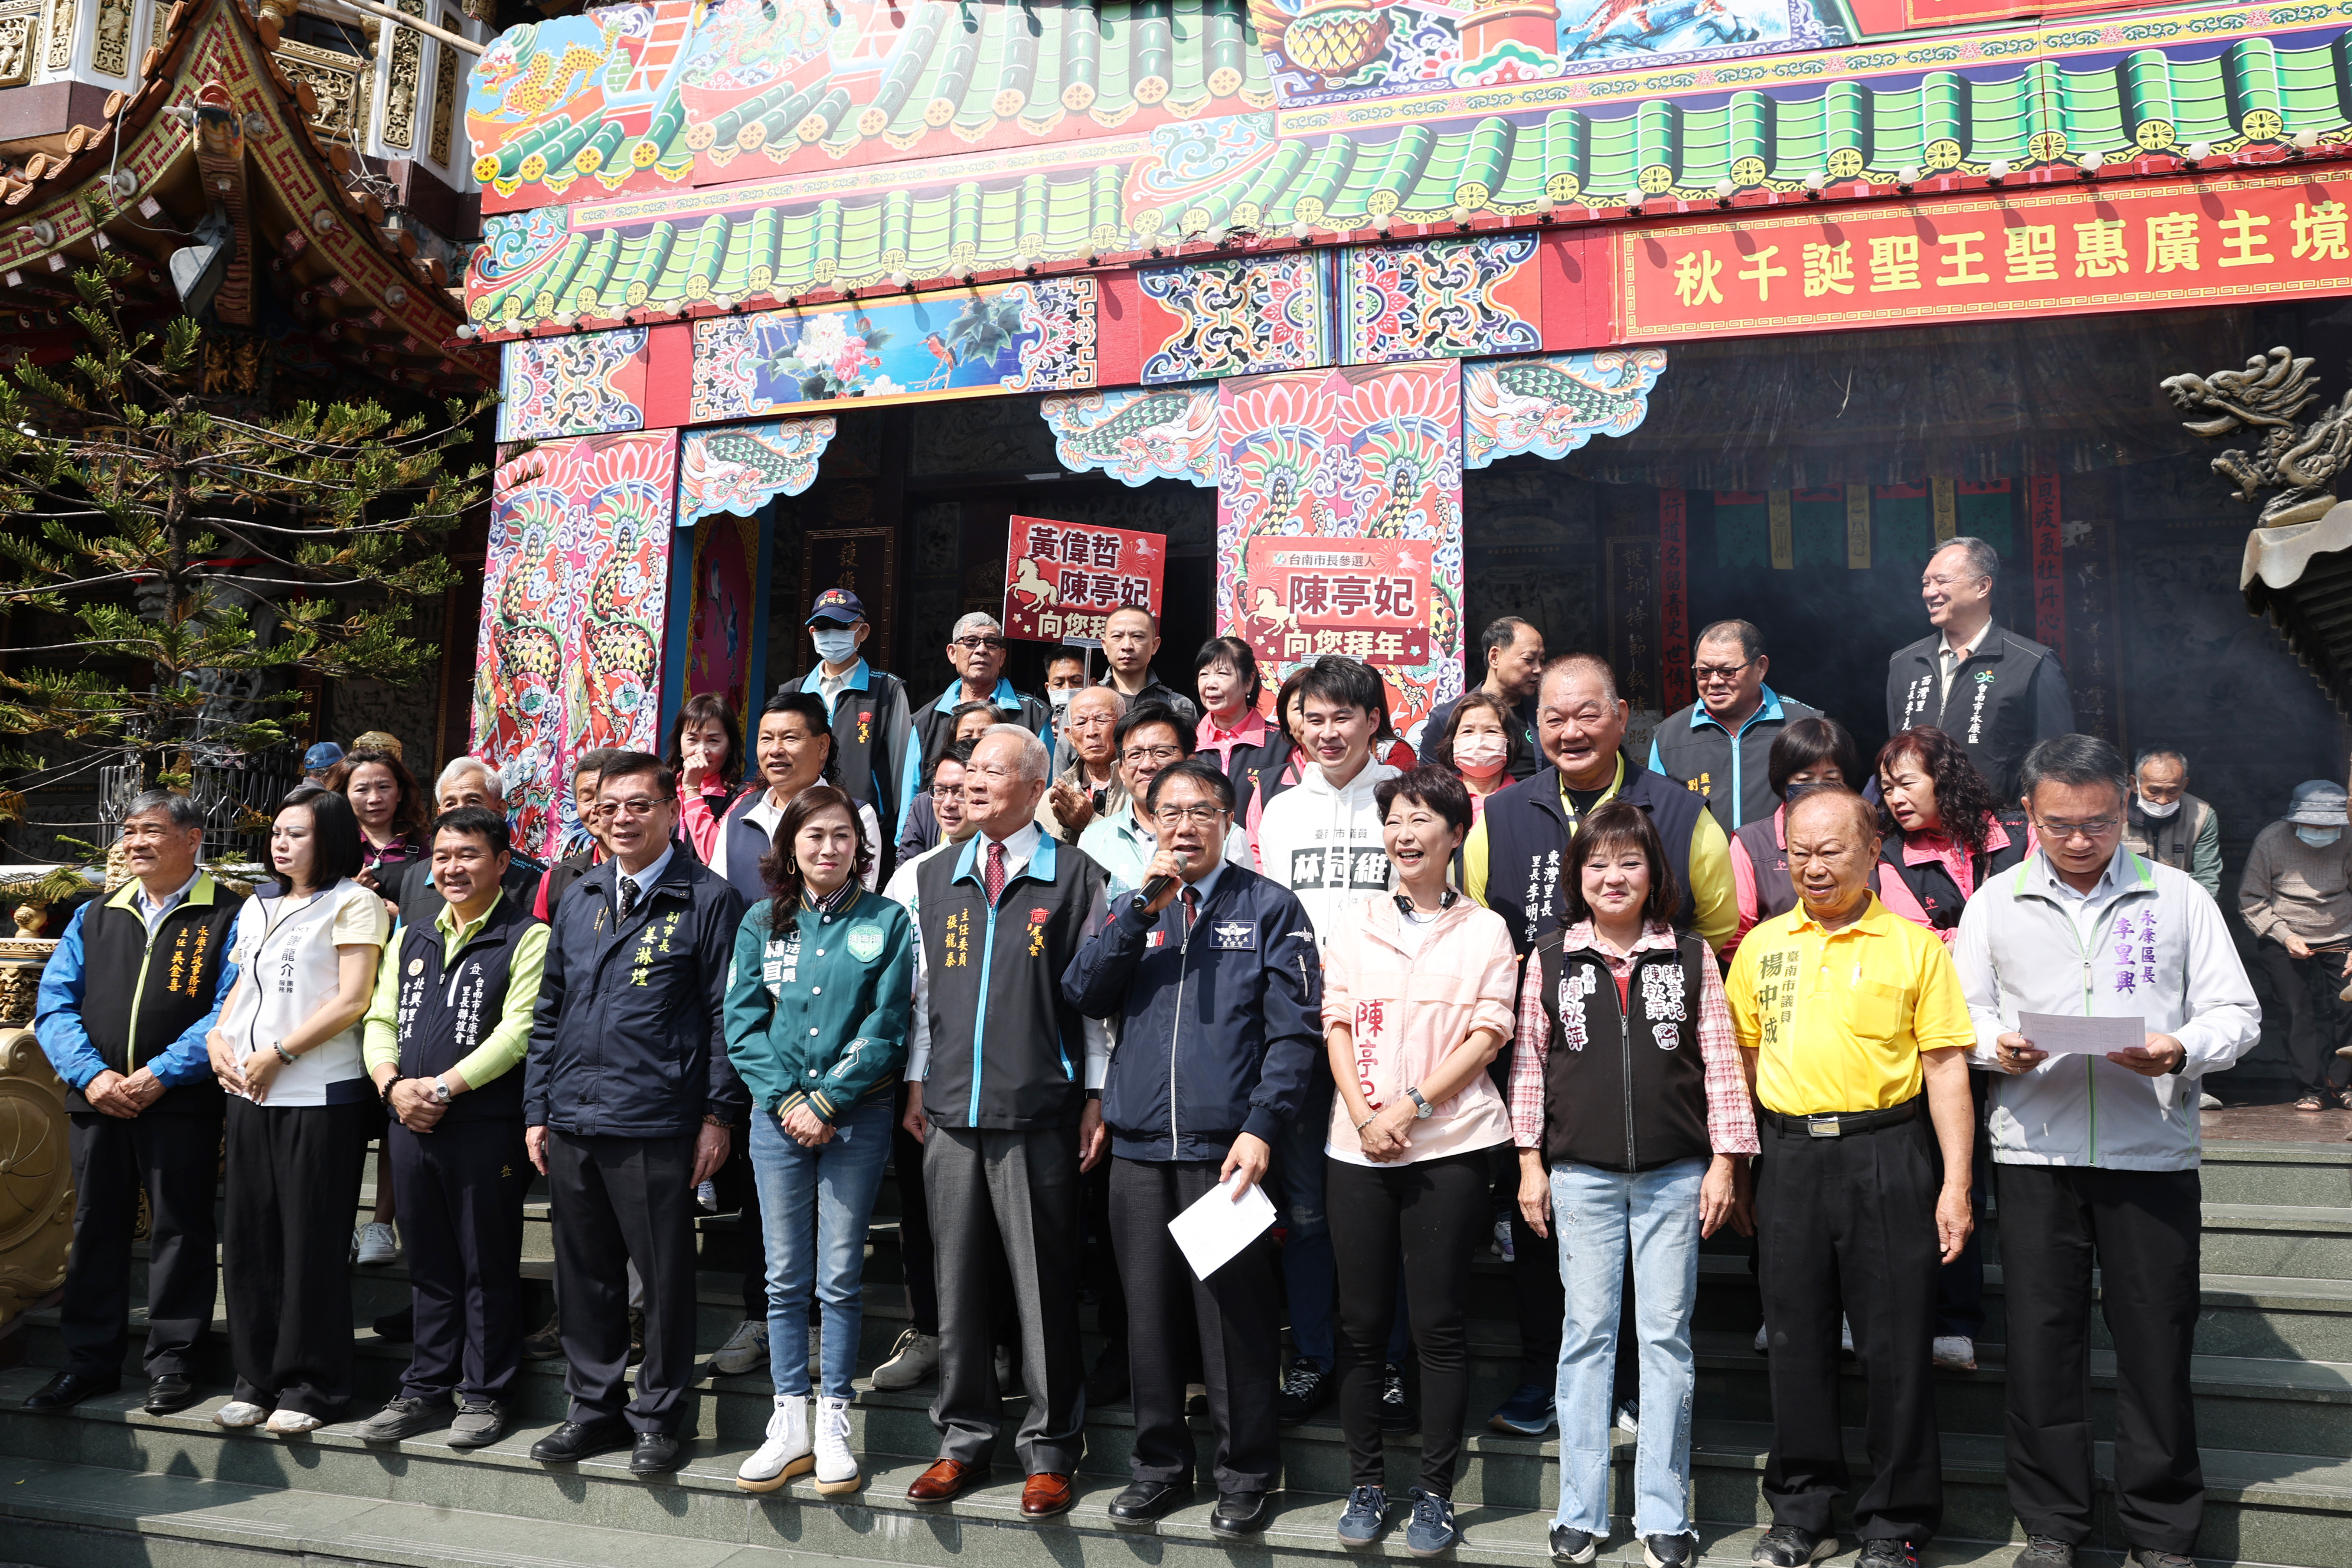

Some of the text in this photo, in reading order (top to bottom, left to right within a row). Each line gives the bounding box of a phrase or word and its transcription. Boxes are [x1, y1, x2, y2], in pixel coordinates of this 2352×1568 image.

[1028, 526, 1120, 569] 黃偉哲
[1289, 554, 1376, 567] 台南市長參選人
[1059, 570, 1149, 610] 陳亭妃
[1289, 575, 1415, 616] 陳亭妃
[1663, 488, 1689, 713] 行道名留青史世傳奇
[1283, 629, 1404, 661] 向您拜年
[1915, 675, 1932, 711] 西灣里
[1968, 683, 1988, 744] 台南市永康區
[1700, 772, 1711, 796] 監事
[1525, 855, 1541, 942] 里長李明堂
[1540, 850, 1560, 916] 東灣里長
[281, 935, 302, 976] 謝龍介
[630, 926, 658, 986] 姜淋煌
[658, 912, 680, 953] 副市長
[781, 929, 801, 982] 立法委員
[945, 914, 958, 968] 張龍泰
[957, 908, 969, 967] 主任委員
[2112, 917, 2136, 994] 李皇興
[2138, 910, 2157, 983] 永康區長
[185, 926, 210, 998] 永康戶政事務所
[1583, 965, 1594, 992] 市議員
[1781, 950, 1799, 1024] 臺南市議員
[404, 977, 425, 1038] 北興里長
[454, 986, 472, 1044] 里長聯誼會
[466, 977, 484, 1045] 台南市永康區
[1561, 979, 1585, 1050] 陳秋萍
[1643, 966, 1665, 1018] 陳秋萍
[1662, 966, 1685, 1018] 陳亭妃
[1759, 952, 1783, 1045] 楊中成
